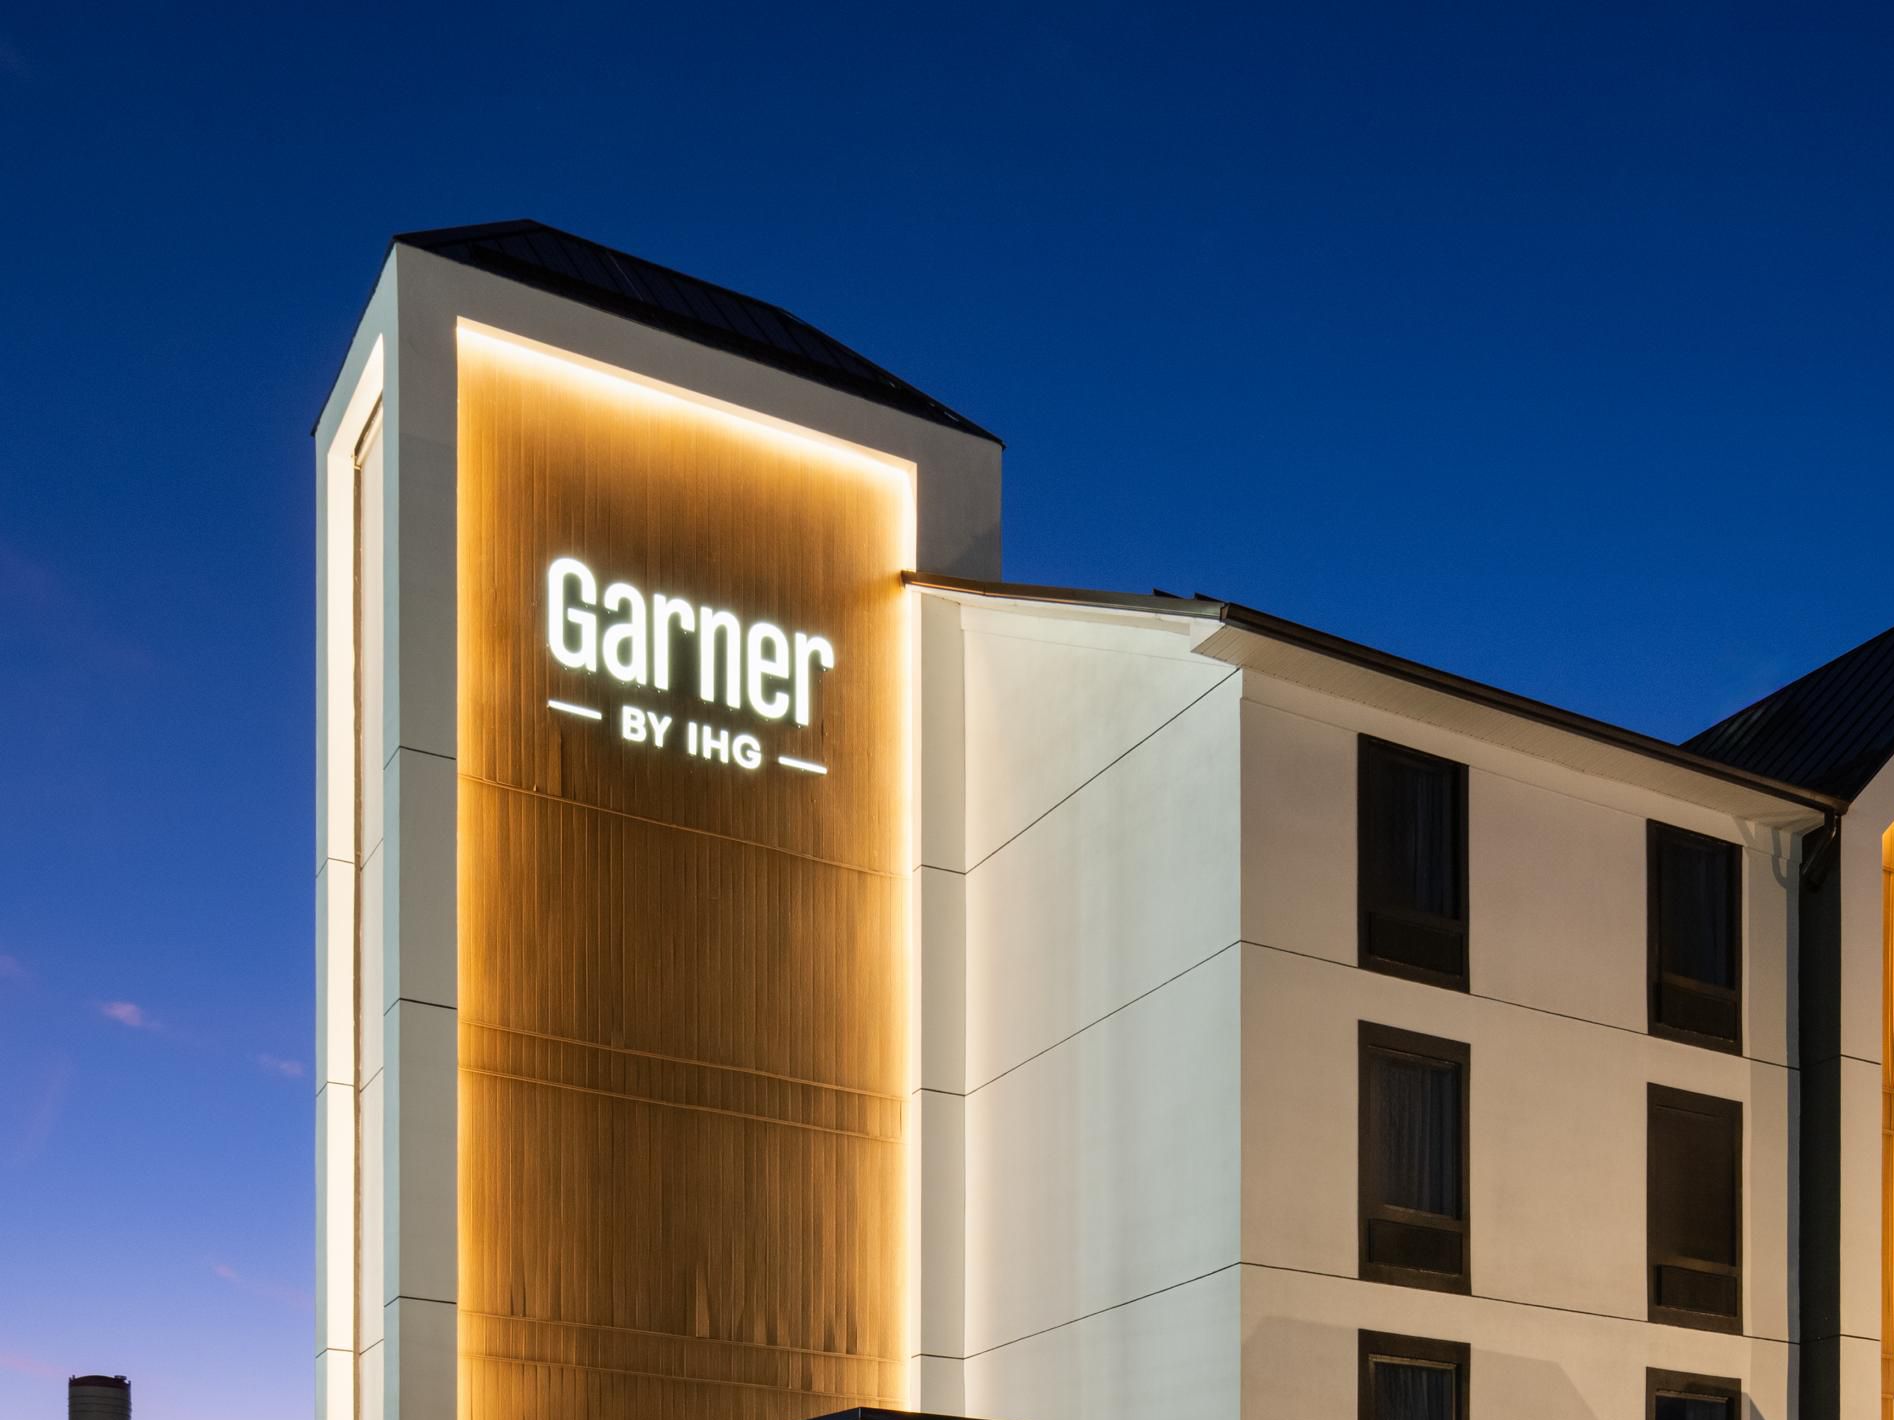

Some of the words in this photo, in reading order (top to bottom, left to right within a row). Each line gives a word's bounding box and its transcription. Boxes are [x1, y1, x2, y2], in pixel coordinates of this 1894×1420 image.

[547, 557, 835, 727] Garner
[621, 705, 672, 748] BY
[687, 720, 763, 770] IHG
